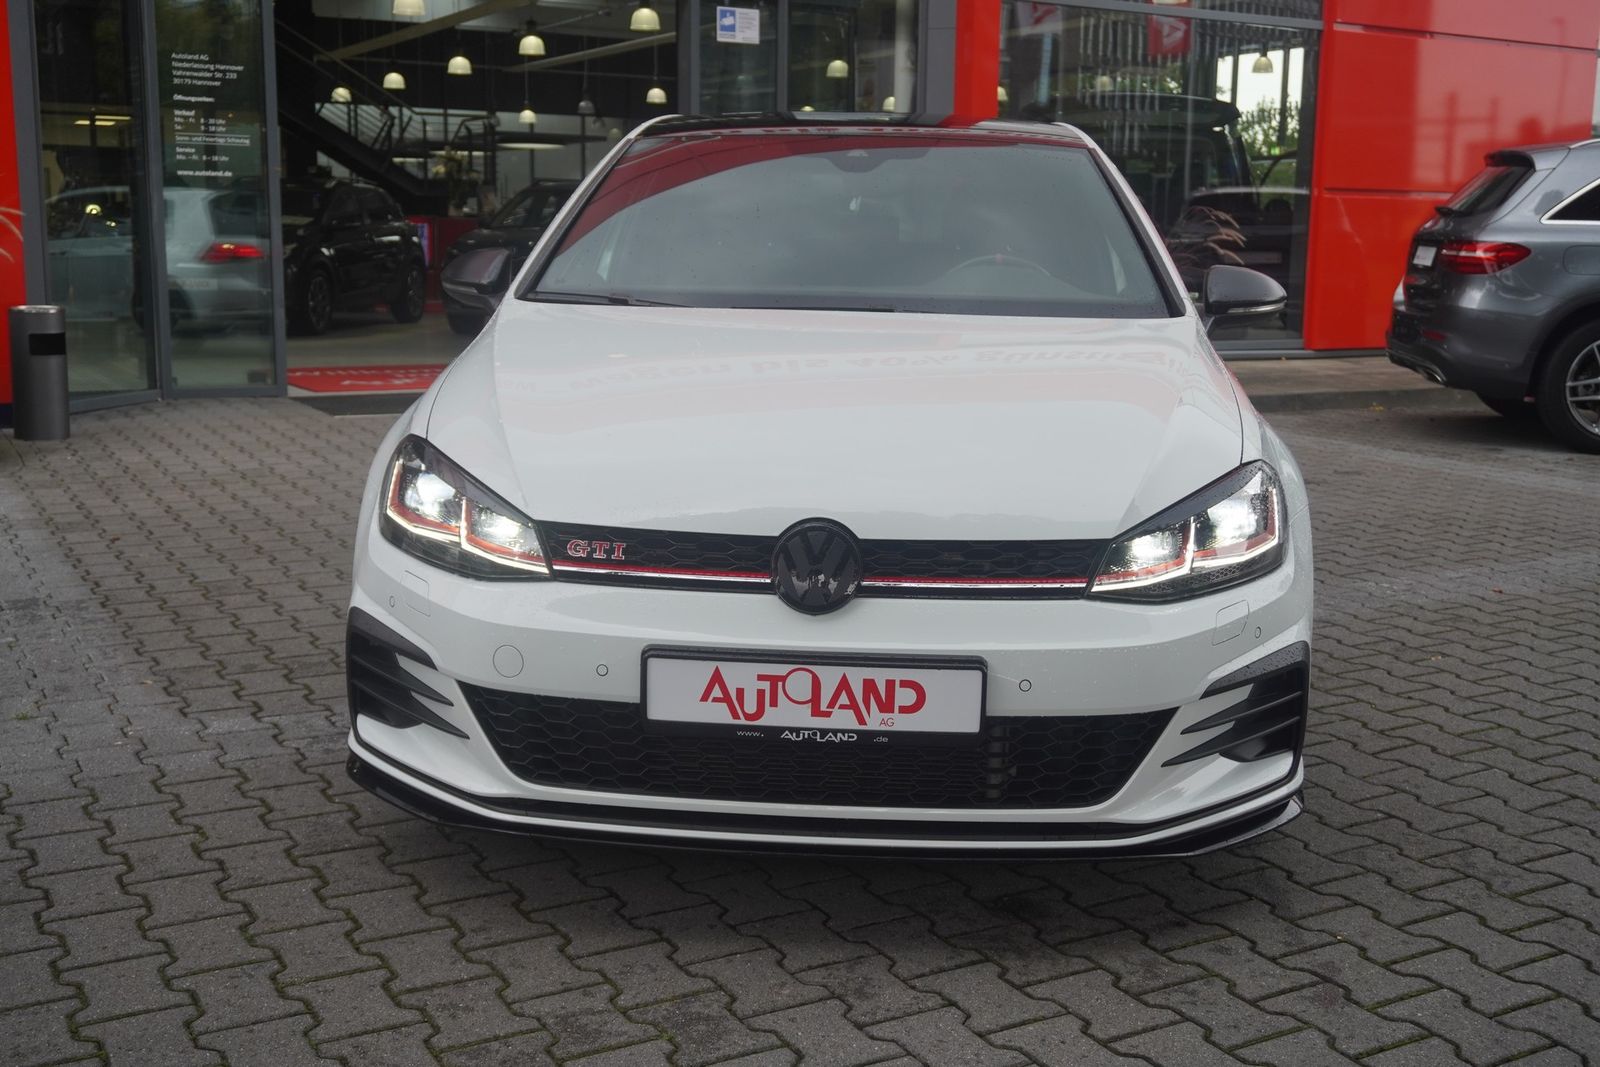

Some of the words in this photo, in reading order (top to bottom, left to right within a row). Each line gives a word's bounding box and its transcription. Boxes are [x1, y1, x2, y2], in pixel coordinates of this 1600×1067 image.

[171, 52, 199, 60] Autoland
[172, 61, 214, 71] Niederlassung
[215, 64, 244, 72] Hannover
[172, 69, 213, 78] Vahrenwalder
[173, 77, 191, 85] 30179
[192, 79, 221, 87] Hannover
[567, 539, 626, 560] GTI
[699, 665, 927, 726] AUTOLAND
[879, 717, 895, 727] AG
[780, 730, 858, 743] AUTOLAND
